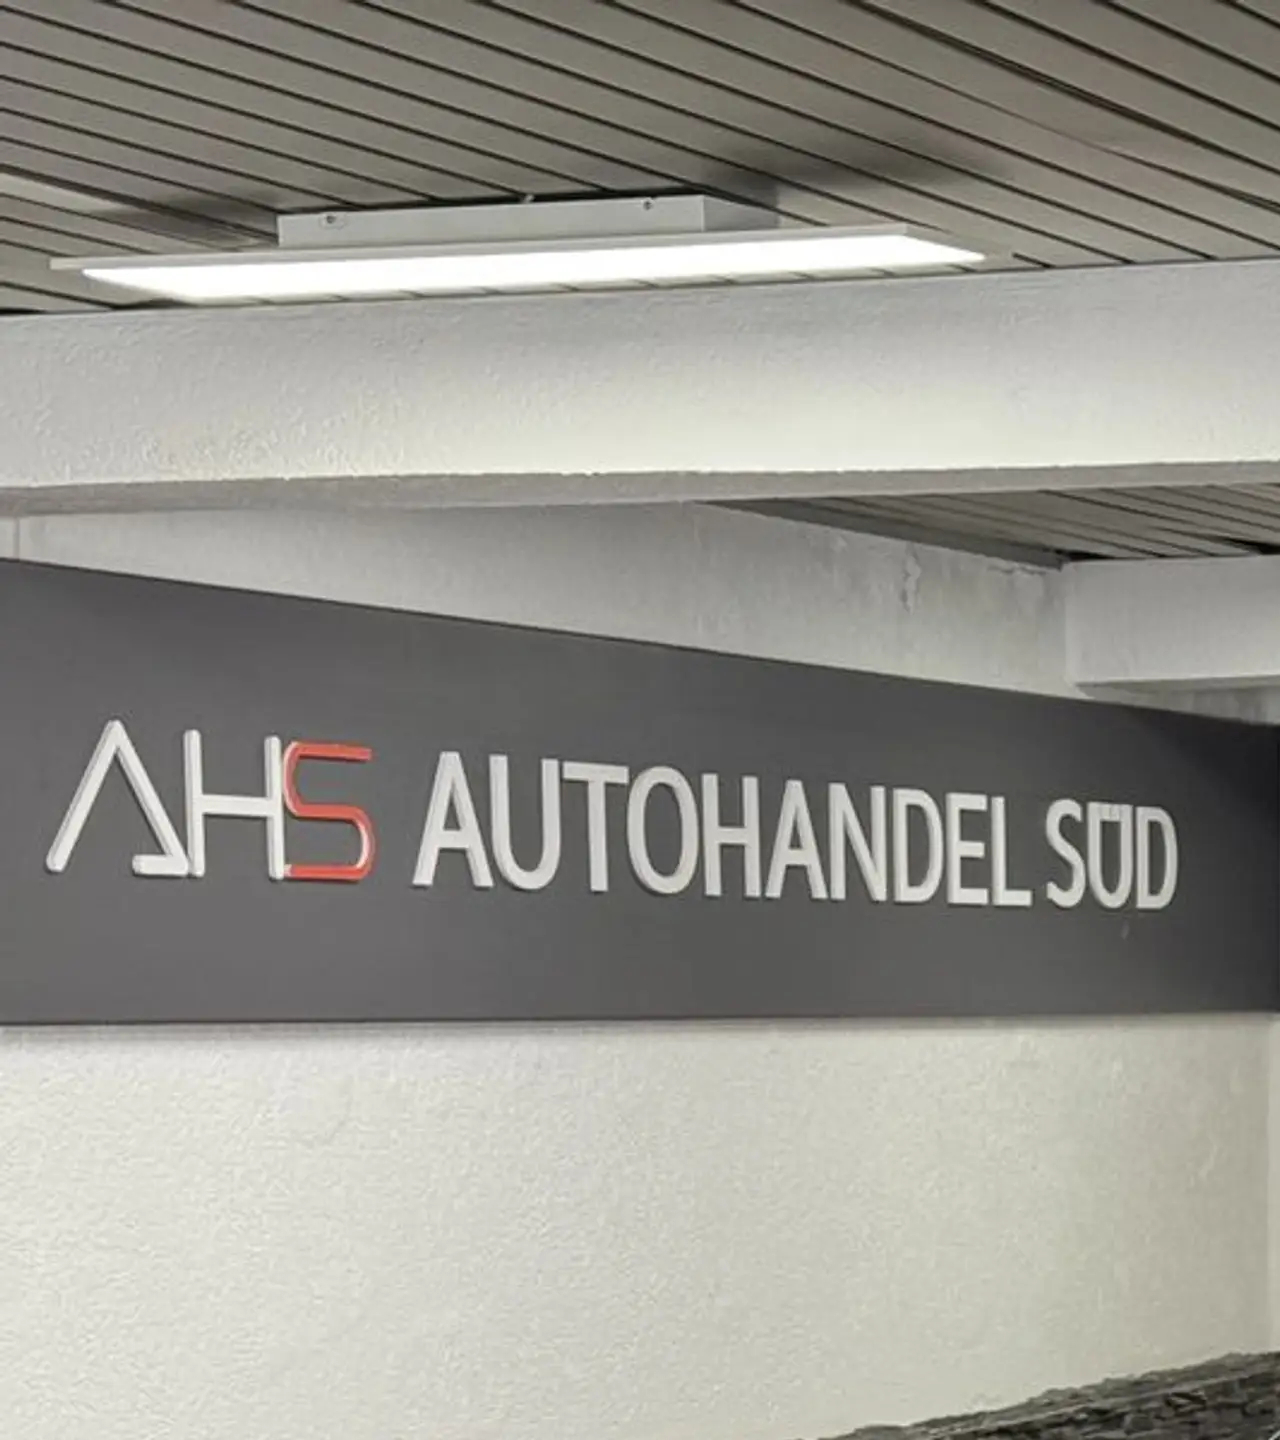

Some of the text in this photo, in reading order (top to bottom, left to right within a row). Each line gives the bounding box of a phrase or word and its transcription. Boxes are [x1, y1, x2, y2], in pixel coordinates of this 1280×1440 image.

[45, 719, 1178, 909] AHS AUTOHANDEL SÜD
